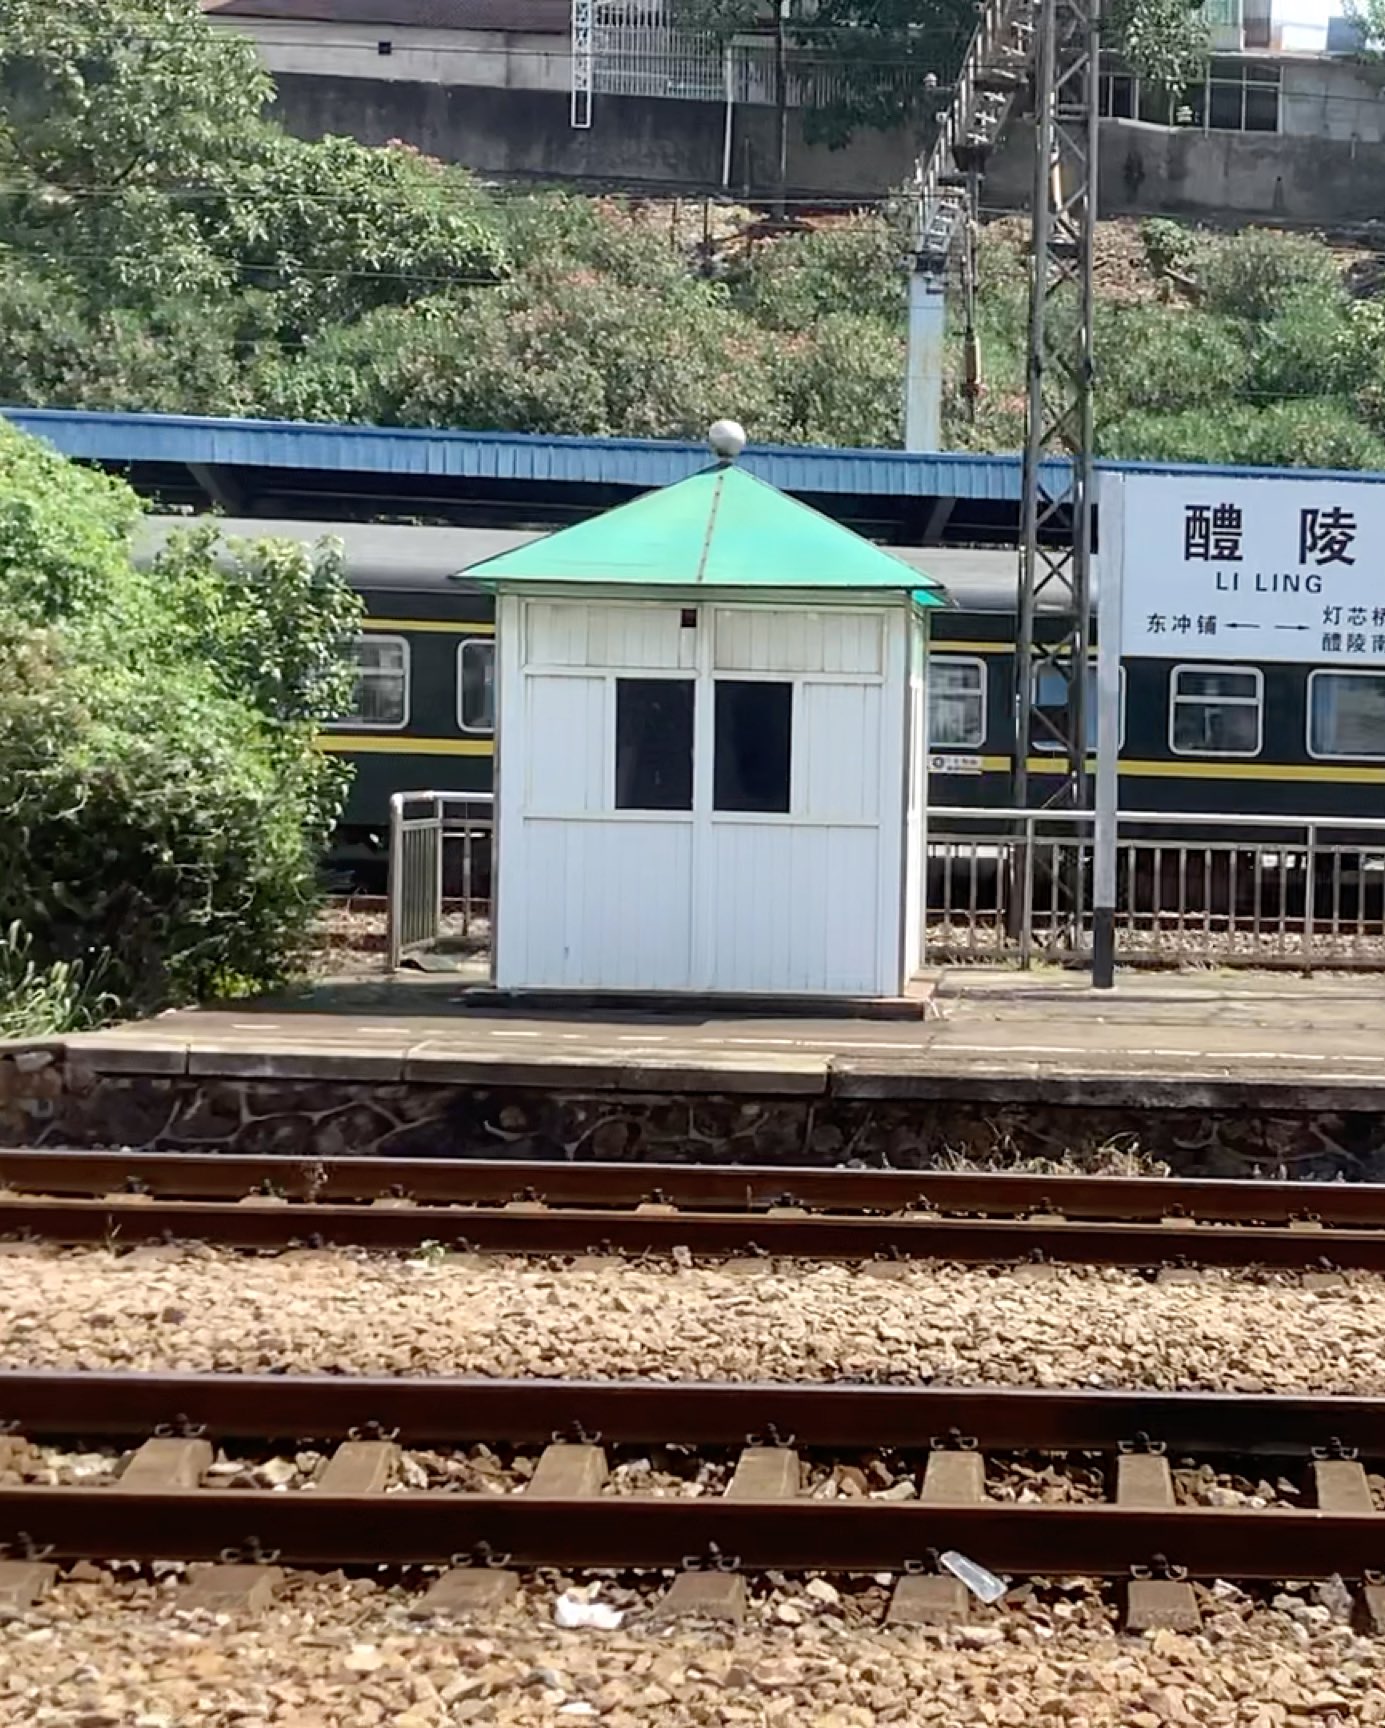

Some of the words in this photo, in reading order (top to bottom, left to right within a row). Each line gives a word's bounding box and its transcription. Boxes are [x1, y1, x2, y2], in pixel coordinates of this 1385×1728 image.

[1184, 503, 1358, 565] 醴陵
[1216, 572, 1239, 591] LI
[1256, 573, 1323, 593] LING
[1147, 613, 1217, 635] 东冲铺
